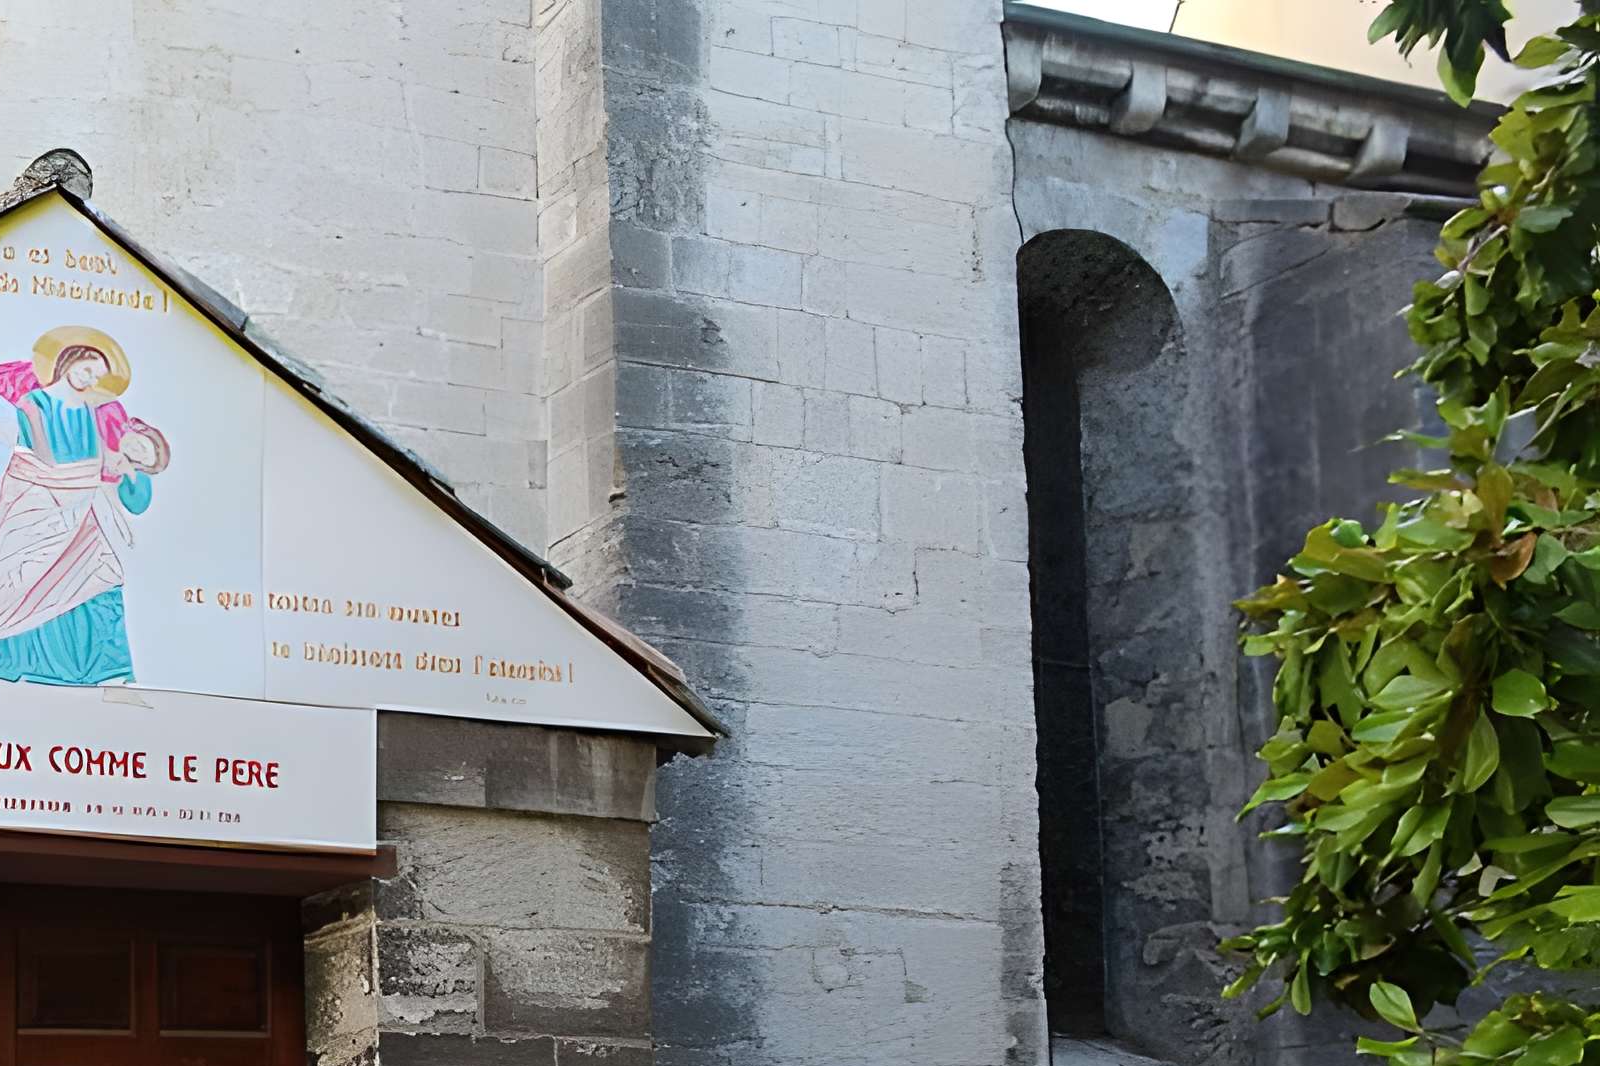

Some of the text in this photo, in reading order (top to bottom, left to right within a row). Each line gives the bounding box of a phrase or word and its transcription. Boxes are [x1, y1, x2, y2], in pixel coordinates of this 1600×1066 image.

[48, 745, 148, 779] COMME
[168, 754, 199, 784] LE
[214, 757, 280, 789] PERE
